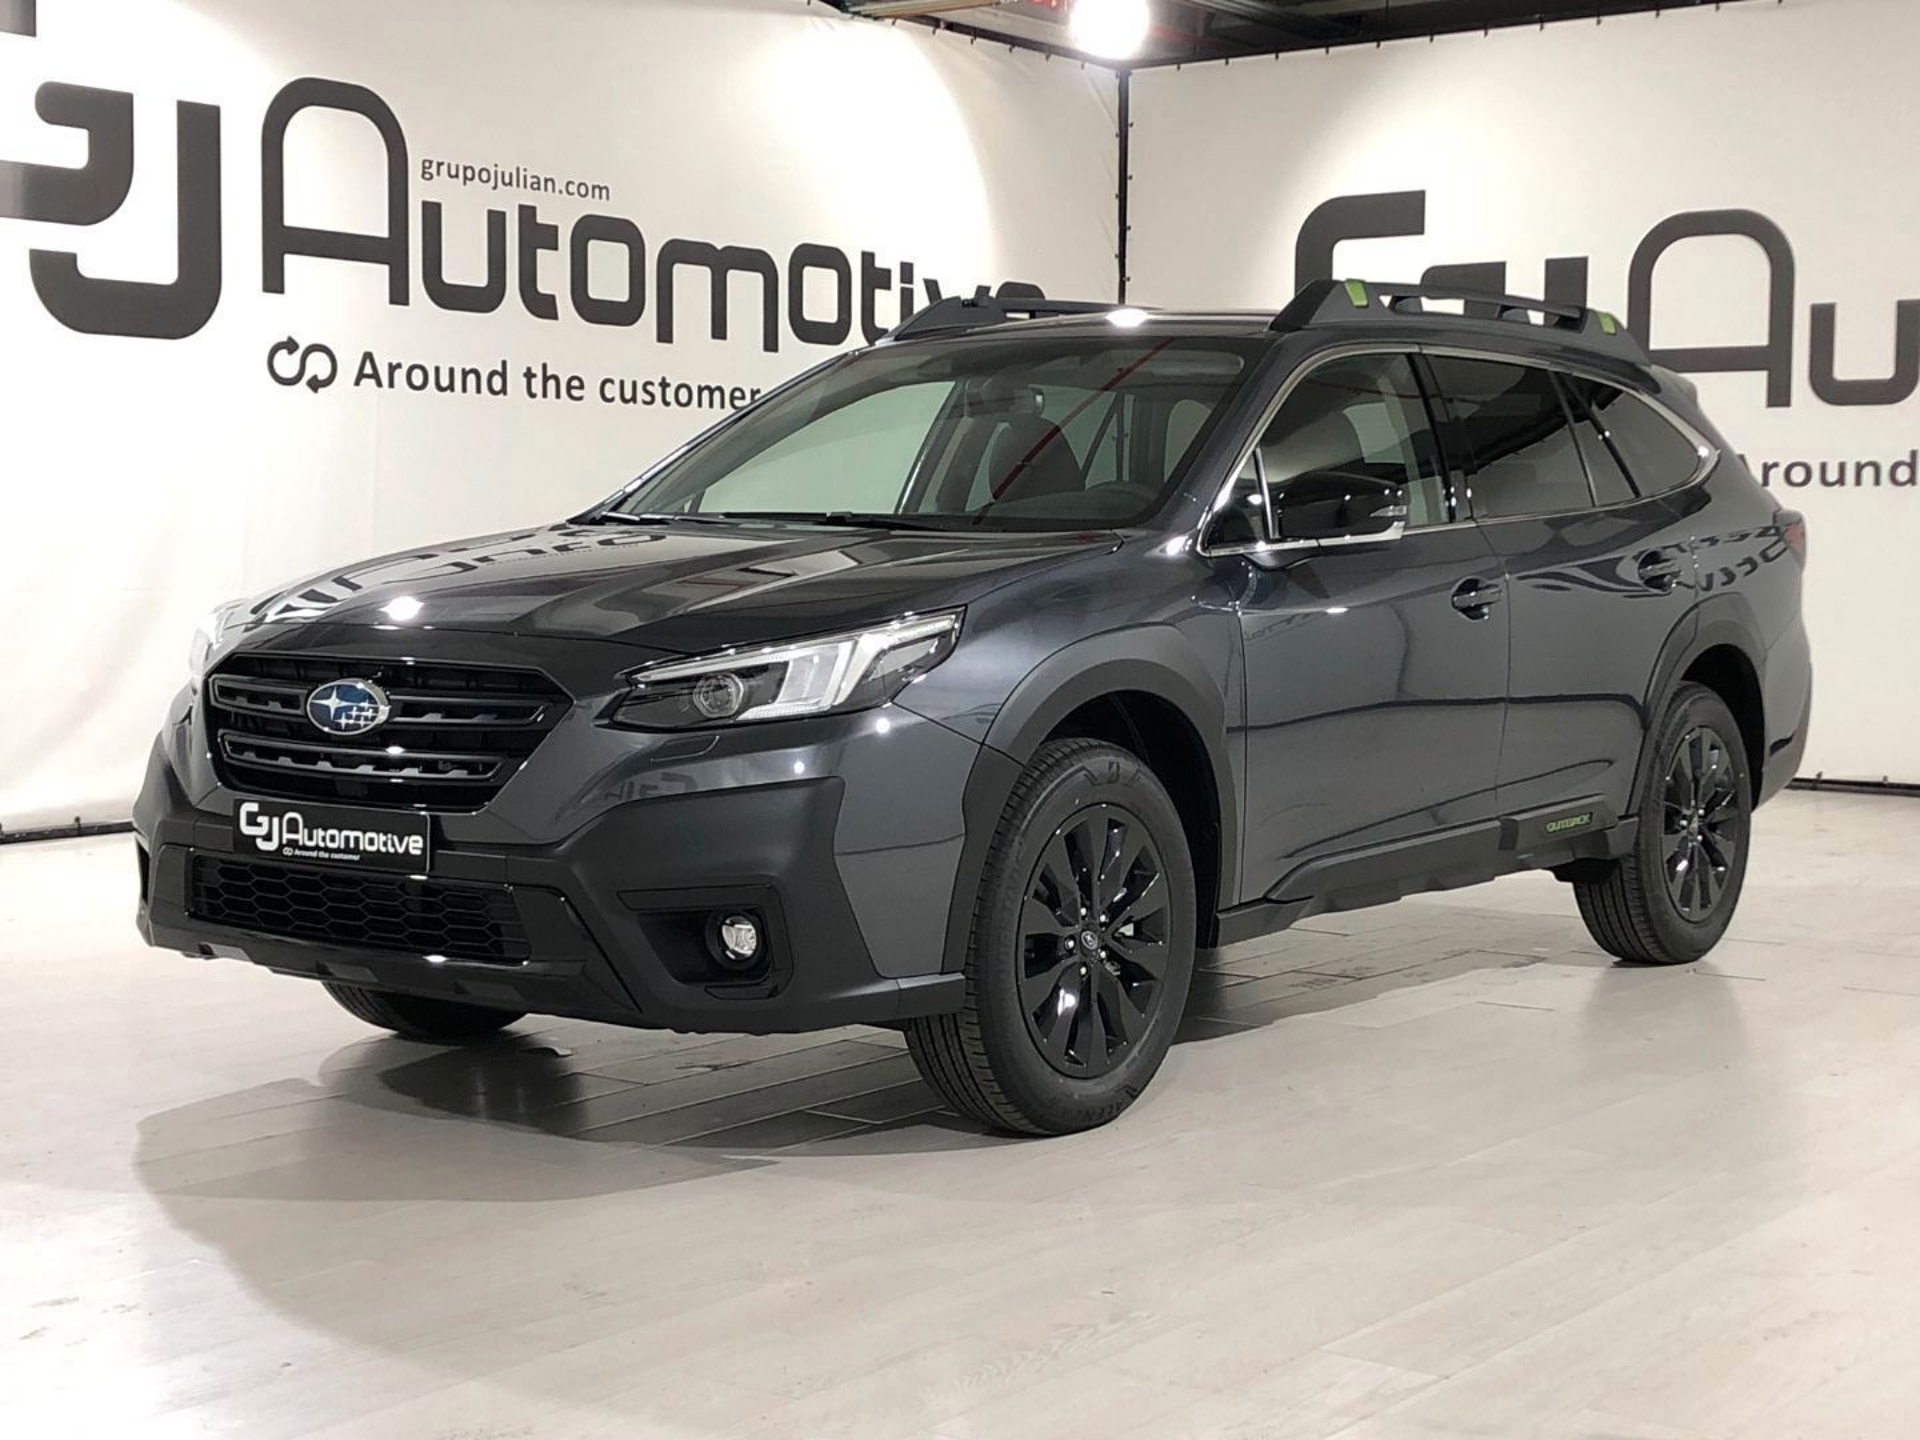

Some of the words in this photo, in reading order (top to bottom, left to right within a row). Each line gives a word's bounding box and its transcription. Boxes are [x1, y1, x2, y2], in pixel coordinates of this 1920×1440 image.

[421, 158, 610, 201] grupojulian.com
[261, 76, 1046, 353] Automoti
[353, 351, 509, 397] Around
[522, 363, 586, 402] the
[599, 376, 761, 410] customer
[1735, 448, 1919, 487] round
[282, 812, 423, 855] Automotive
